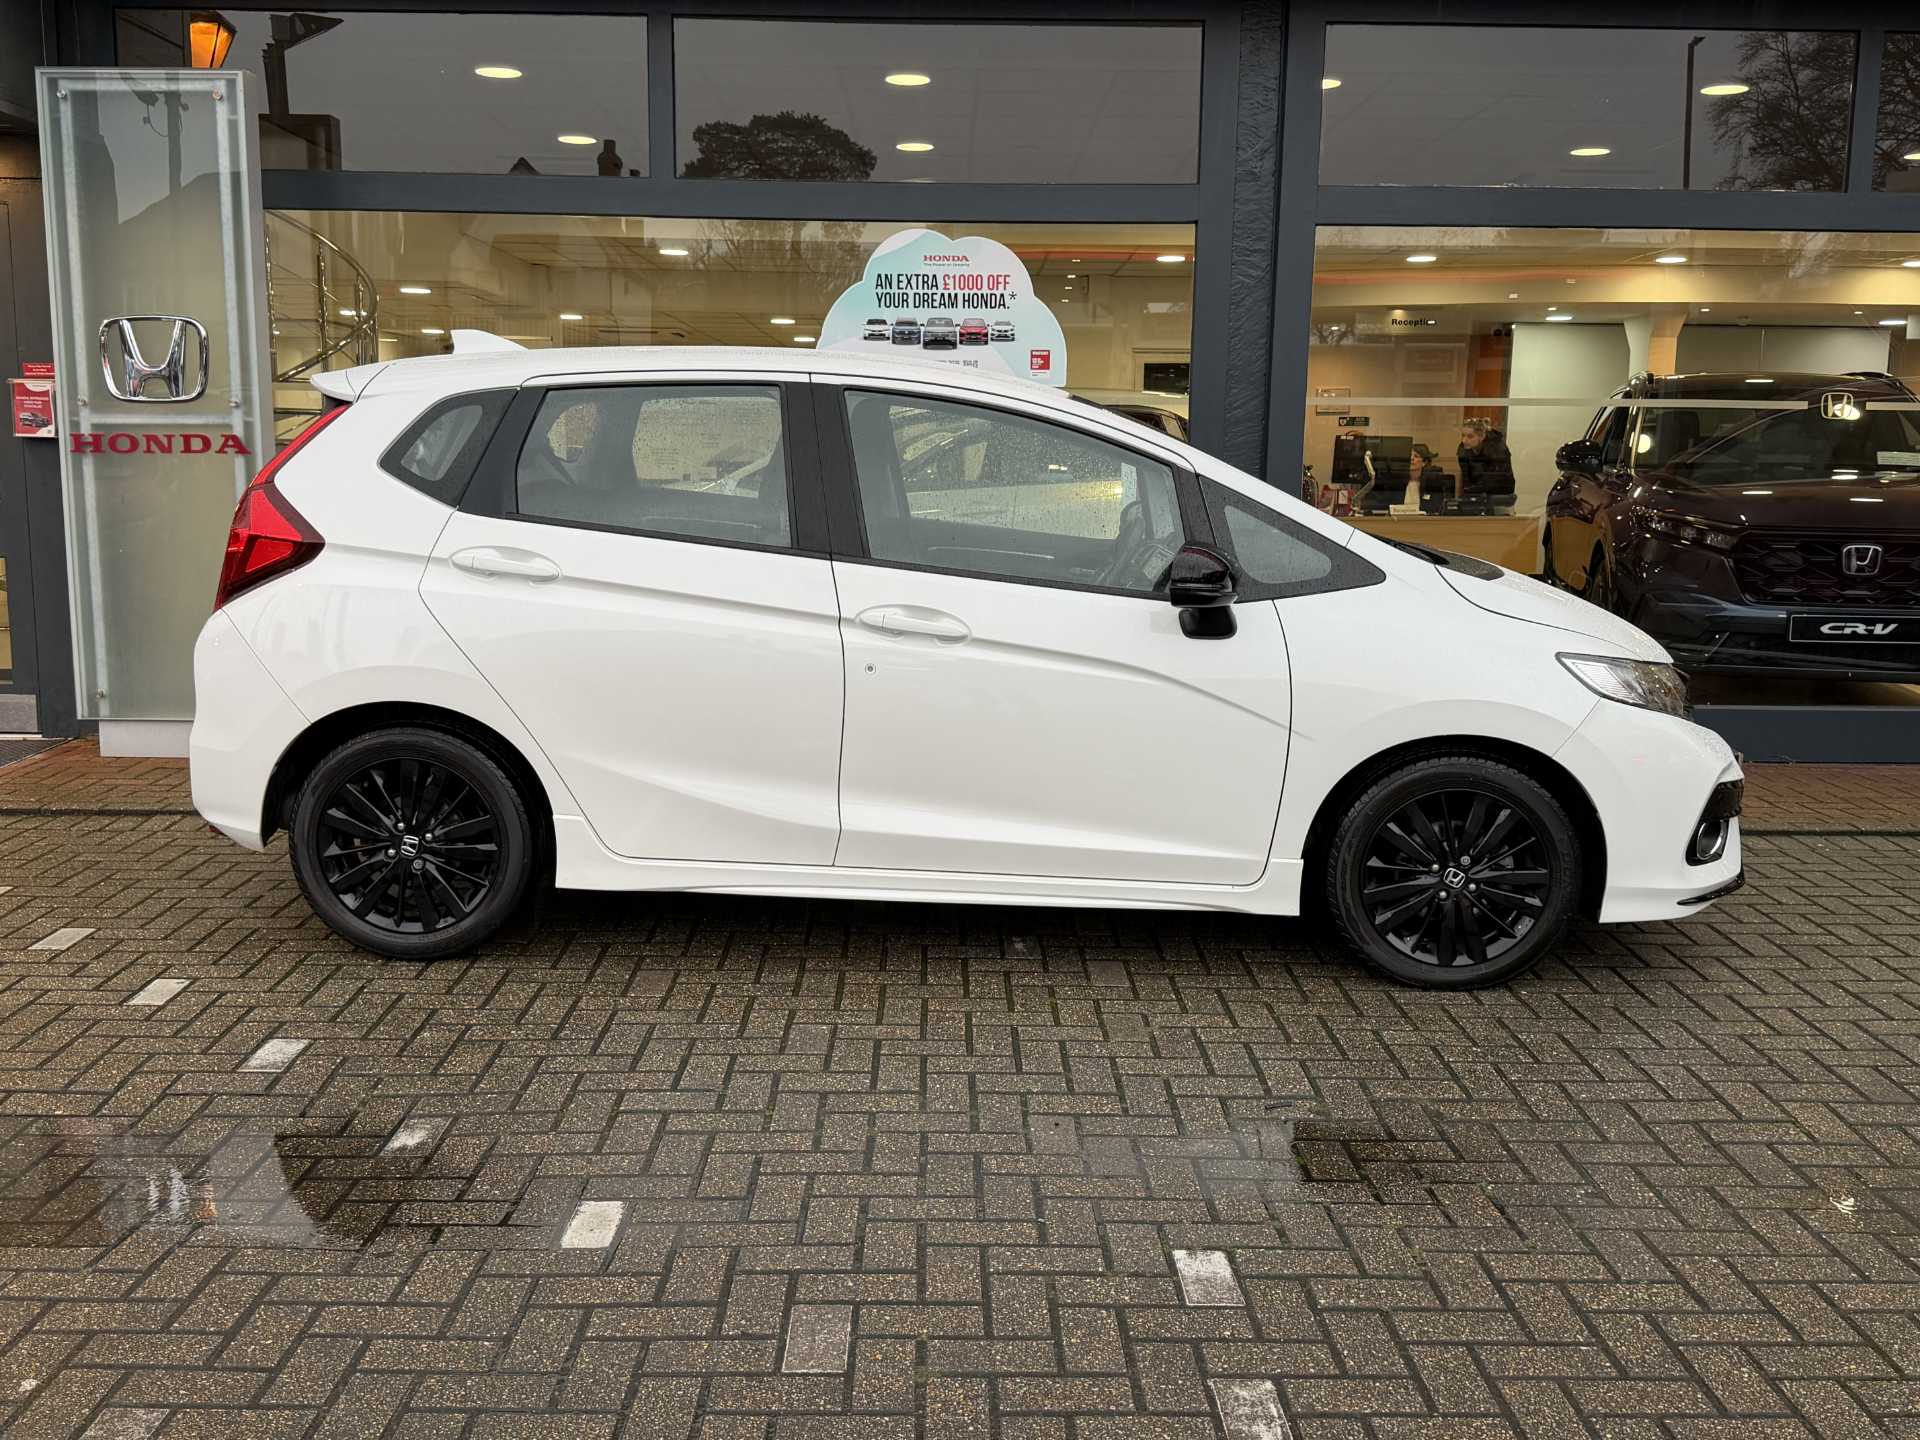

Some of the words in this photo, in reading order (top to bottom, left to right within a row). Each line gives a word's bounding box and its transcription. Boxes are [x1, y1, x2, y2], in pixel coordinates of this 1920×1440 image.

[875, 273, 893, 290] AN
[897, 273, 939, 291] EXTRA
[942, 273, 984, 291] £1000
[987, 274, 1011, 291] OFF
[876, 291, 909, 309] YOUR
[913, 292, 958, 309] DREAM
[1391, 318, 1437, 327] Recepti
[69, 432, 252, 455] HONDA
[1820, 622, 1899, 635] CR-V
